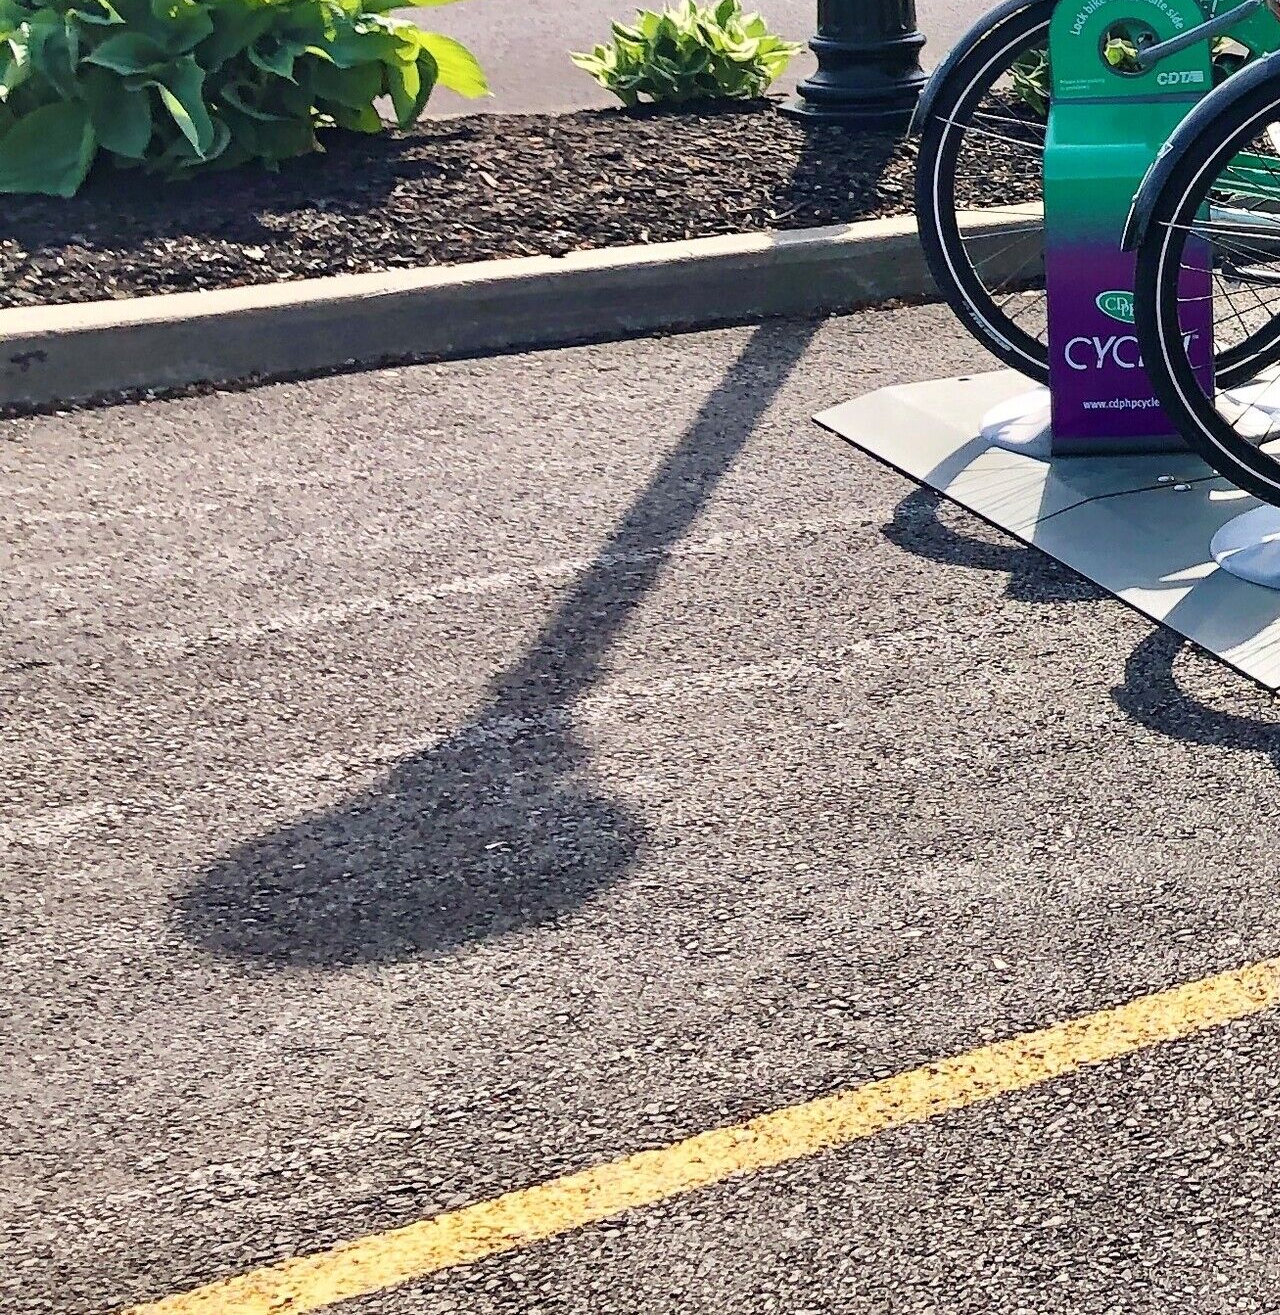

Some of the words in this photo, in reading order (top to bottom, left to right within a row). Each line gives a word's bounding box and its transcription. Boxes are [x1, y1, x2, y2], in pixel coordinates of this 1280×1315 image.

[1069, 11, 1087, 36] Lock
[1166, 7, 1184, 30] side
[1157, 70, 1204, 86] CDTA
[1083, 397, 1161, 411] www.cdphpcycle
